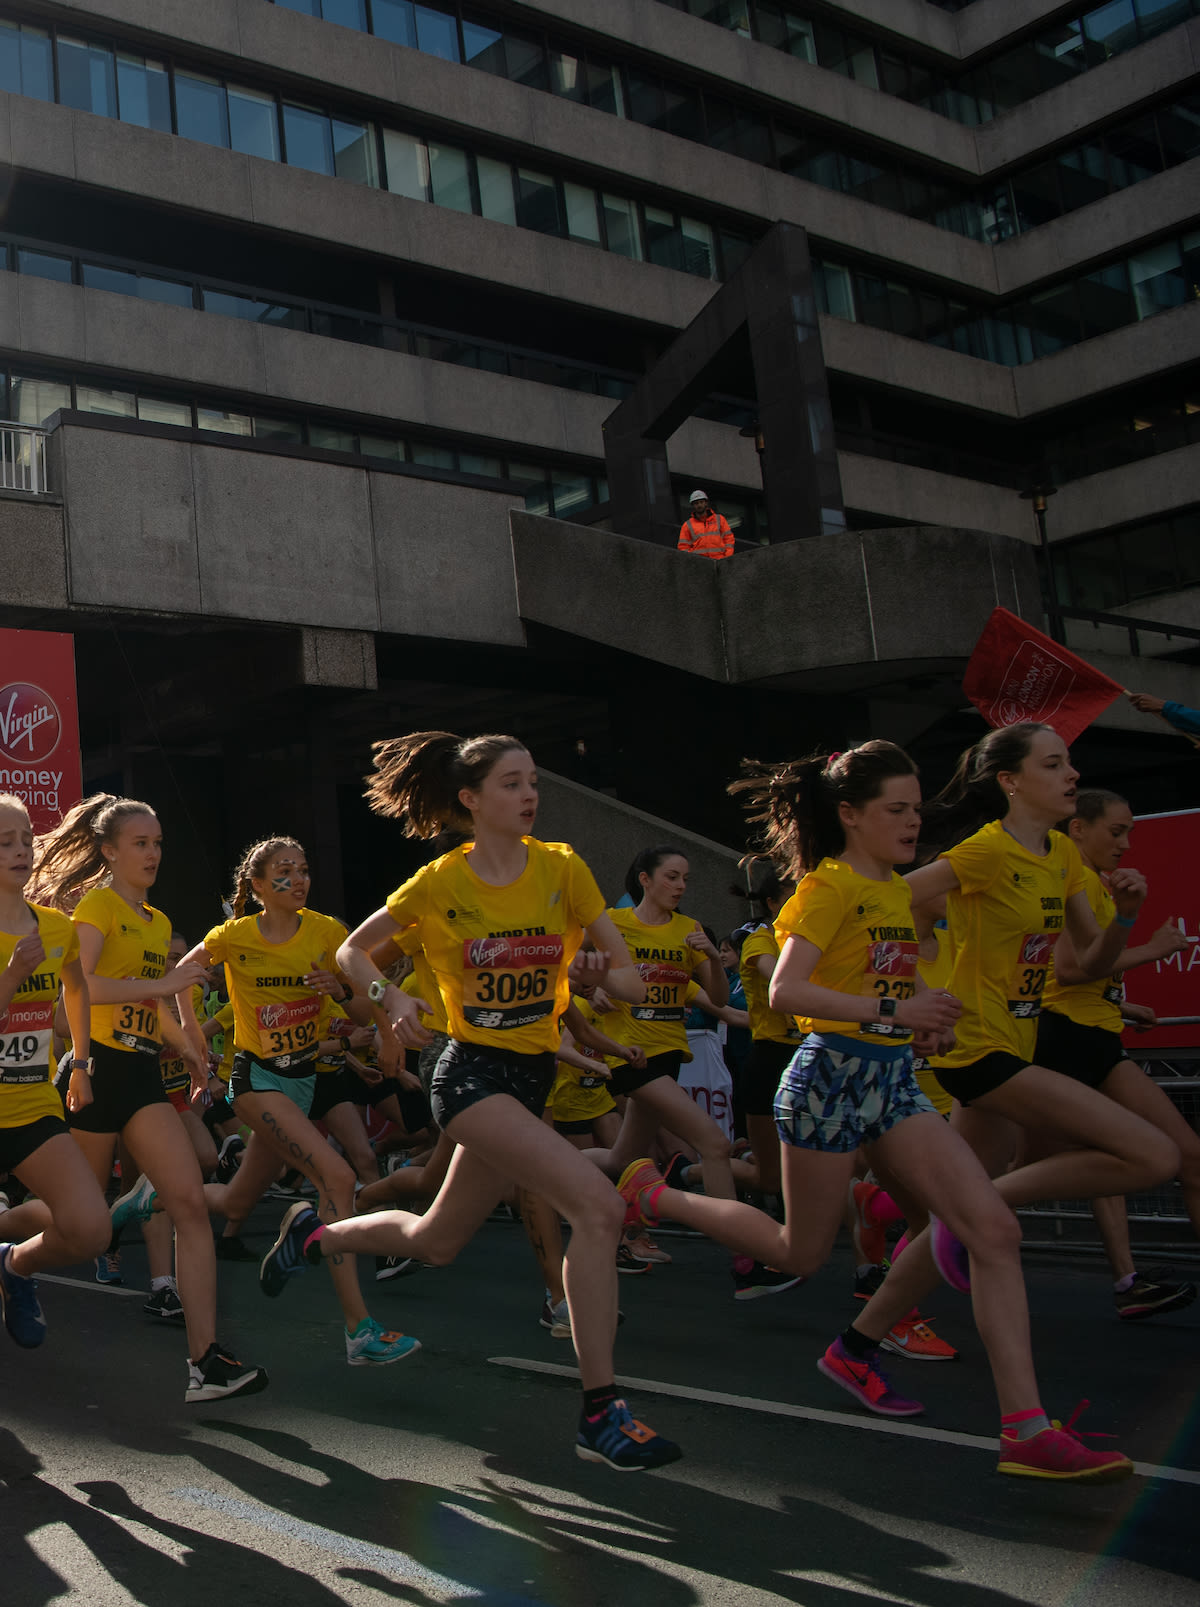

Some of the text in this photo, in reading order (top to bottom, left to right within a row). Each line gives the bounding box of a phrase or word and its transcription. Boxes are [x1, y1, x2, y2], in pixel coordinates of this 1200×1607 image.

[471, 938, 563, 967] Virgin money
[635, 947, 683, 962] WALES
[141, 965, 161, 980] EAST
[476, 968, 549, 1003] 3096
[11, 1009, 51, 1022] money
[262, 1003, 287, 1029] Virgin
[270, 1020, 316, 1053] 3192
